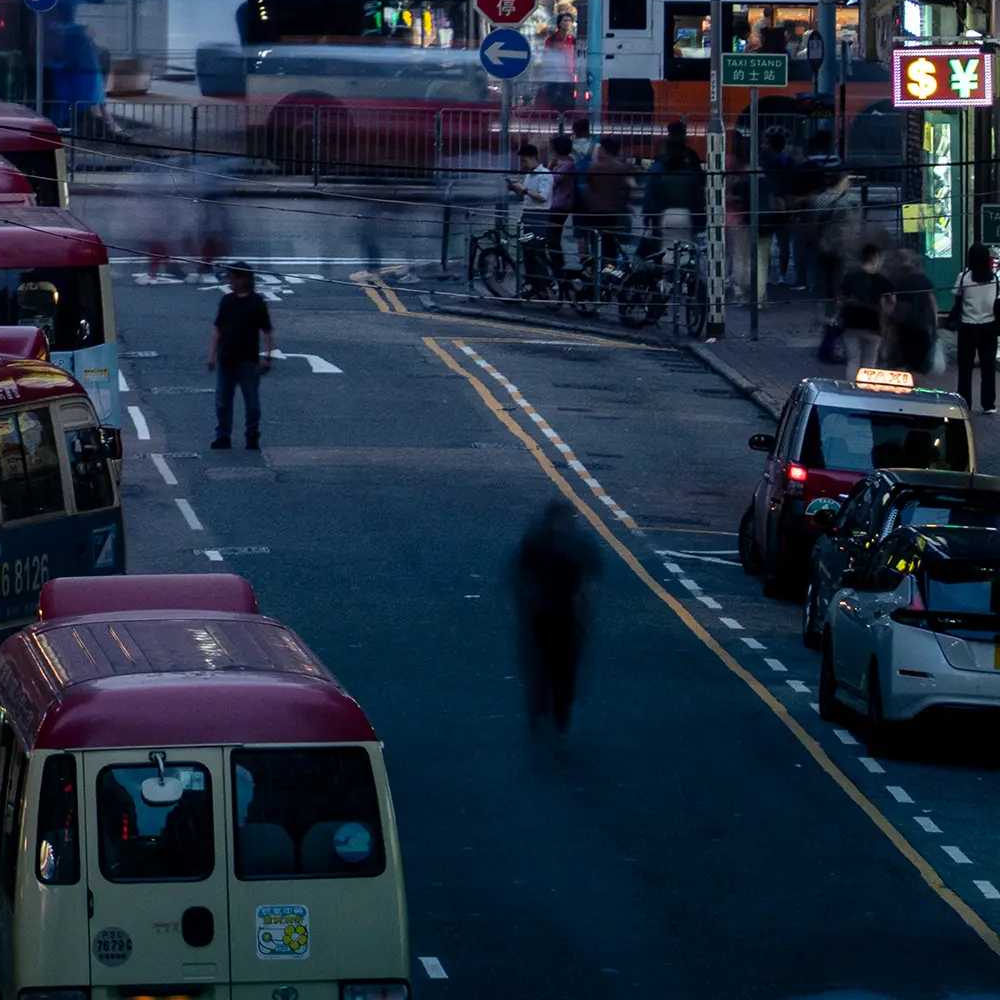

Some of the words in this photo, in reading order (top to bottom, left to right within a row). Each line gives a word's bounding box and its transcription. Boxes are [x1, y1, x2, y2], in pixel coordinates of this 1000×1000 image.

[726, 59, 748, 67] TAXI
[750, 59, 783, 67] STAND
[733, 69, 776, 81] 的士站
[864, 369, 908, 384] TAXI
[13, 552, 50, 596] 8126
